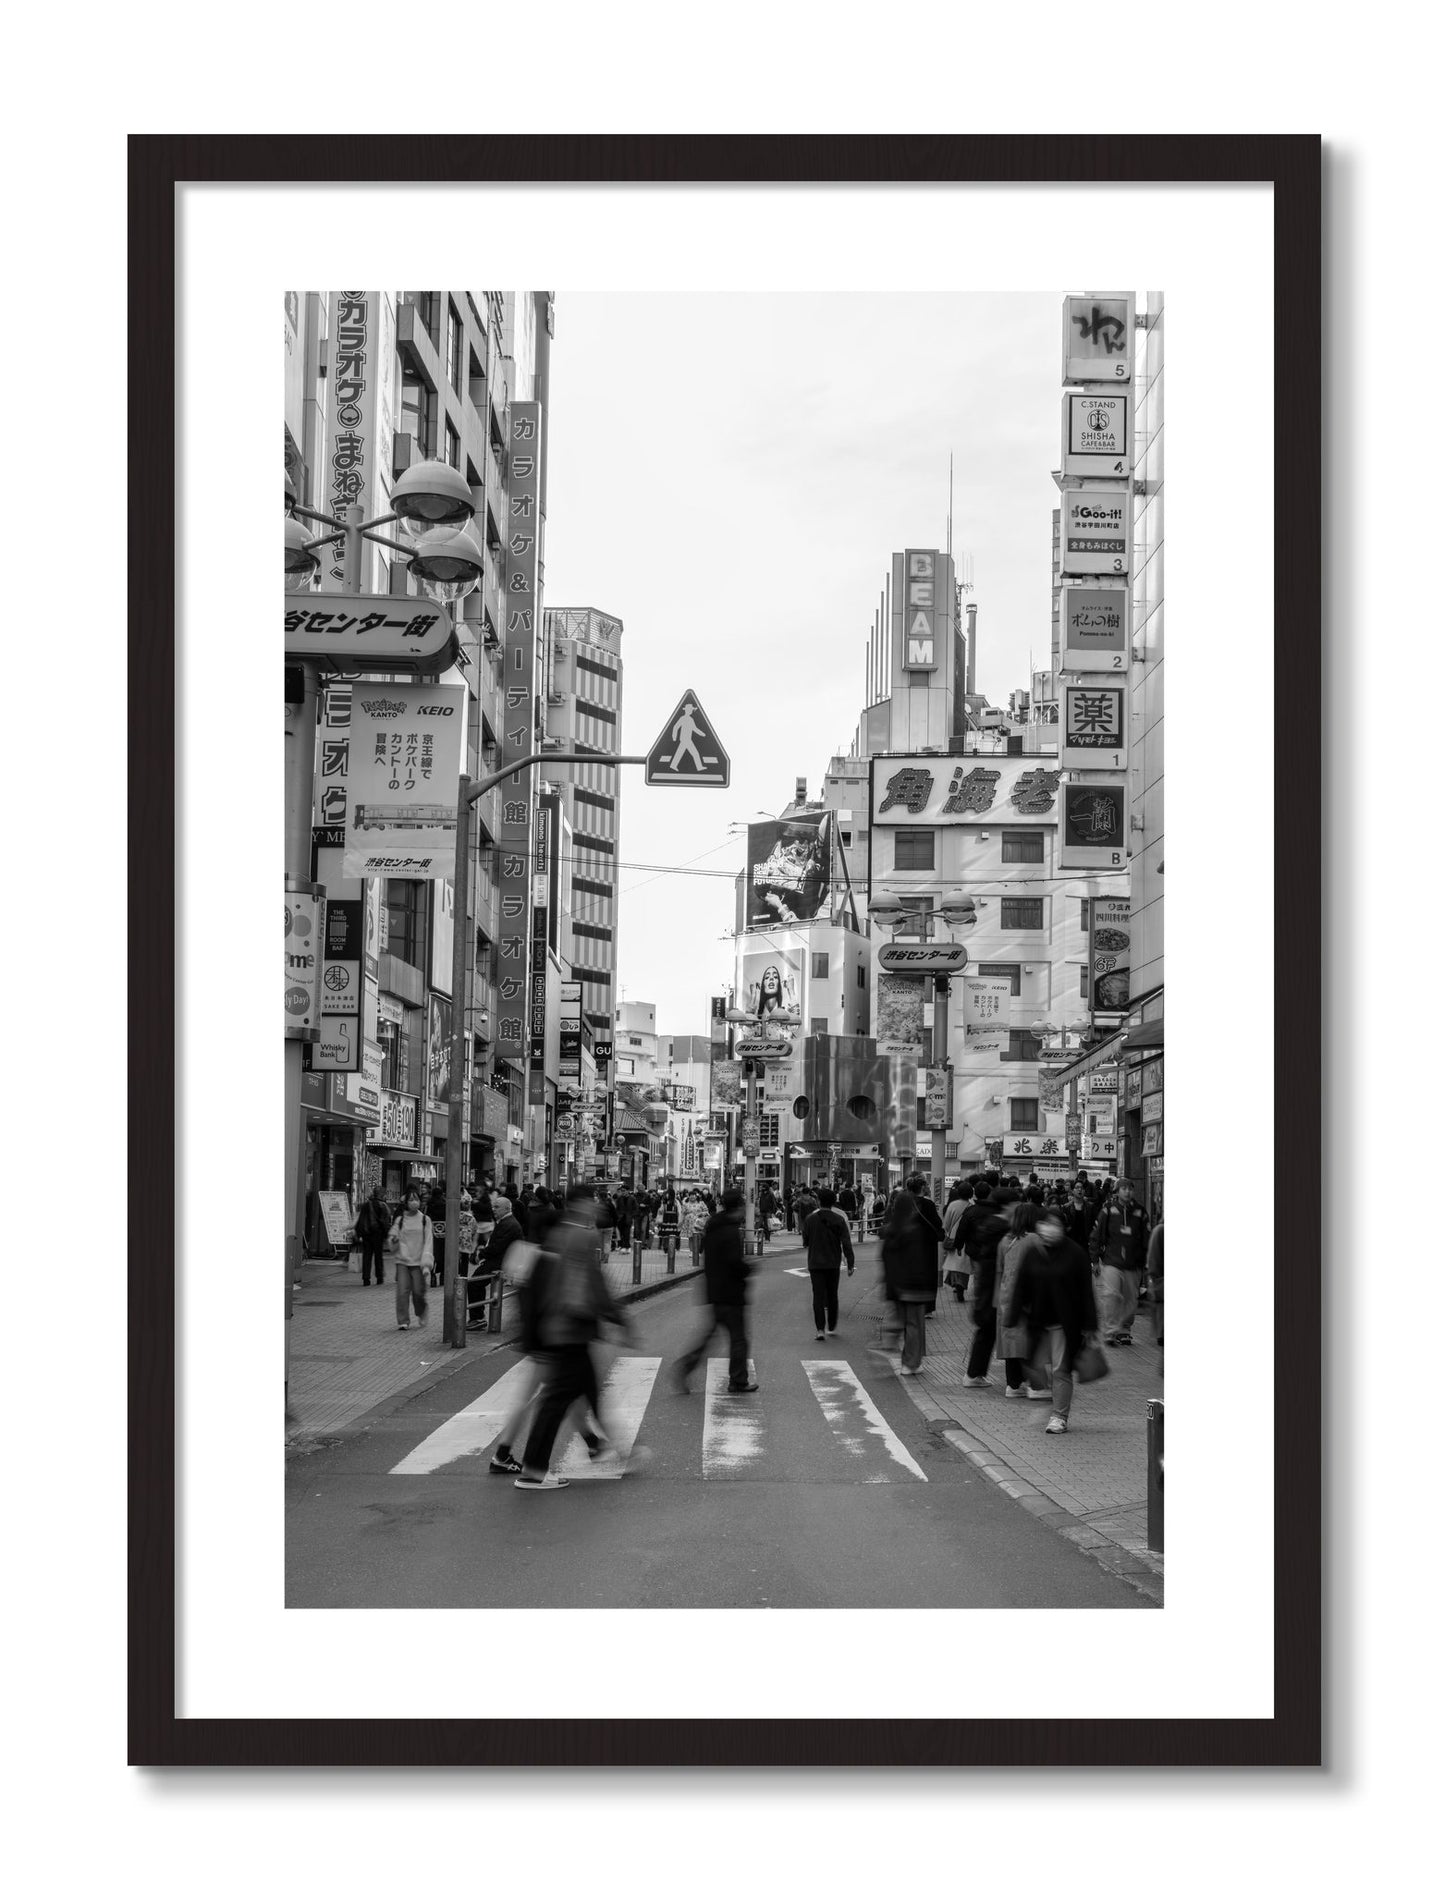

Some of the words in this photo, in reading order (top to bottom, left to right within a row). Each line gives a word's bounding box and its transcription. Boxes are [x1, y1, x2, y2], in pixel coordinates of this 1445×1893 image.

[336, 298, 367, 406] カラオケ
[1115, 364, 1125, 377] 5
[1080, 431, 1116, 441] SHISHA
[1113, 461, 1124, 474] 4
[1080, 506, 1123, 520] Goo-it!
[1070, 541, 1123, 551] 全身もみほぐし
[1113, 558, 1123, 571] 3
[908, 553, 934, 665] BEAM
[1112, 655, 1123, 668] 2
[416, 705, 455, 717] KEIO
[1073, 692, 1113, 733] 薬
[373, 733, 388, 767] 冒険へ
[420, 733, 435, 780] 京王線で
[388, 733, 403, 791] カントーの
[1112, 753, 1119, 766] 1
[878, 766, 1062, 814] 角海老
[538, 812, 546, 840] kimono
[364, 857, 433, 868] 渋谷センター街
[1111, 852, 1121, 865] B
[499, 855, 526, 1042] カラオケ館
[883, 950, 963, 961] 渋谷センター街
[1093, 956, 1117, 973] 6F
[320, 1043, 346, 1053] Whisky
[595, 1046, 612, 1055] GU
